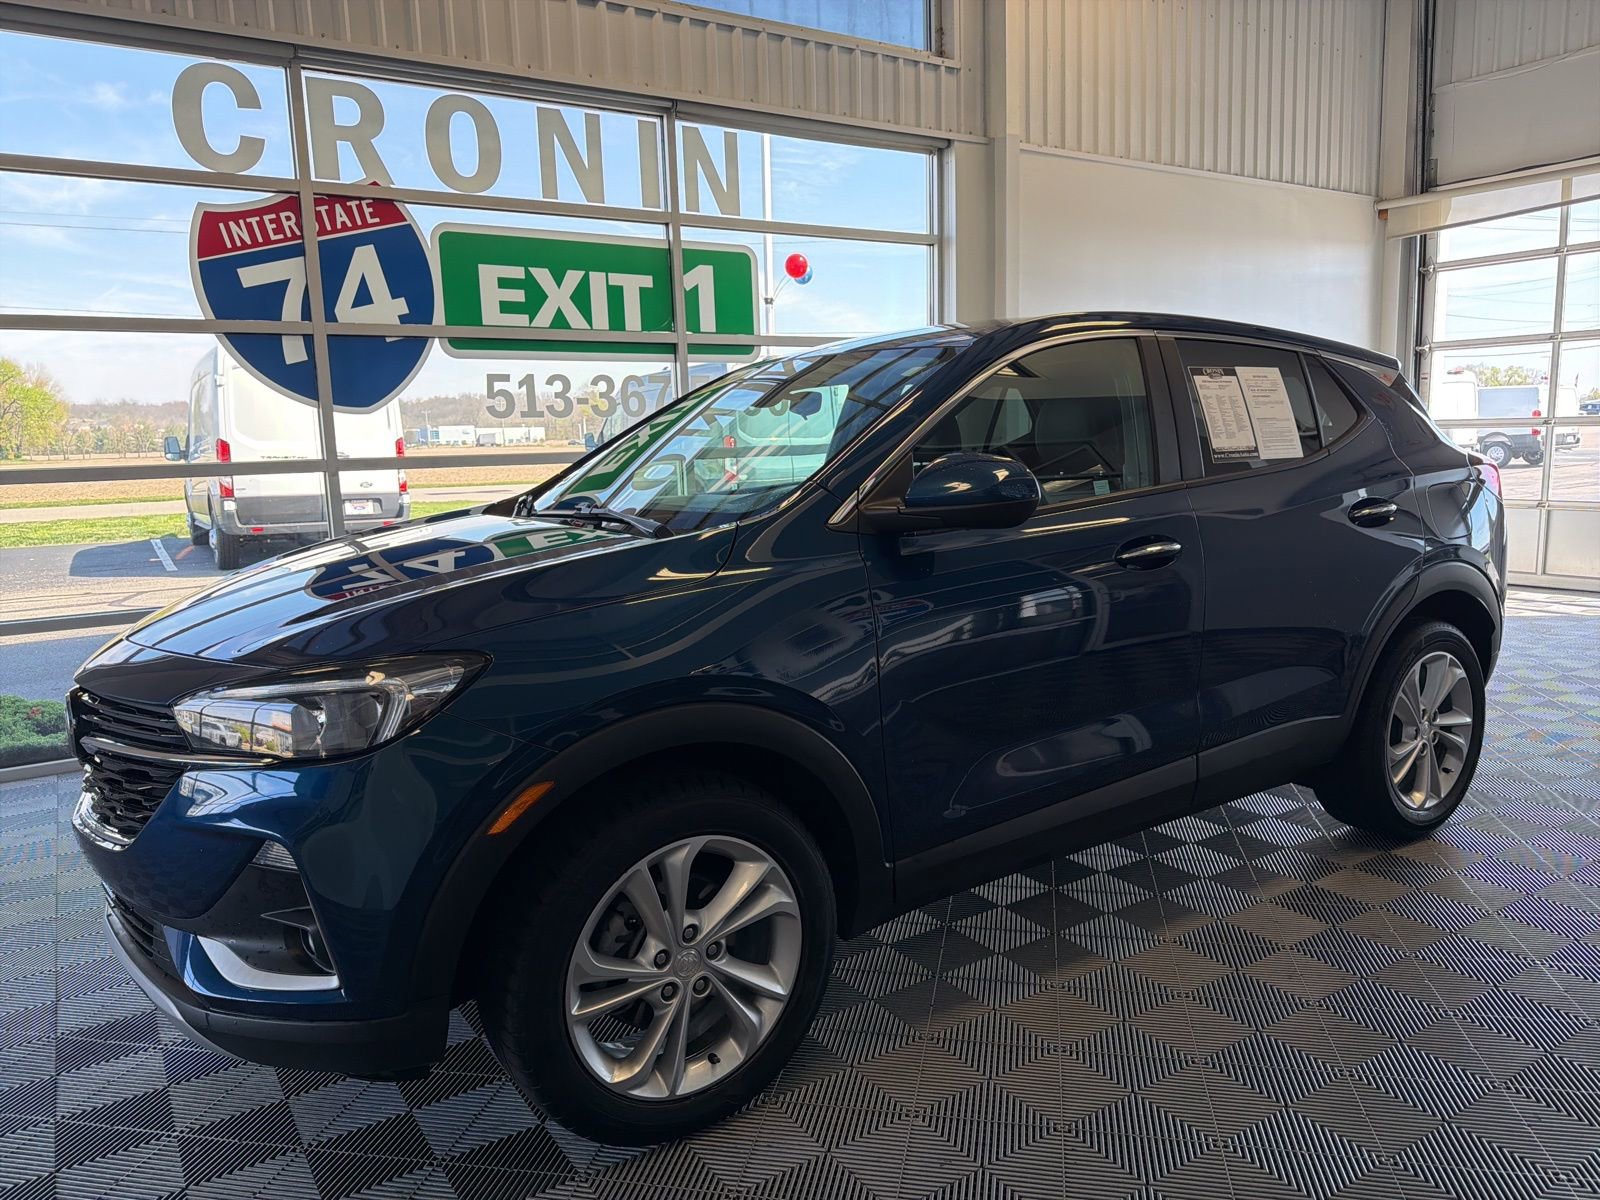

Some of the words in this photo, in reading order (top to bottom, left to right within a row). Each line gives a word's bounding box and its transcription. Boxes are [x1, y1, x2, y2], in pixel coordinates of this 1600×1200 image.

[171, 62, 741, 217] CRONIN
[218, 199, 380, 249] INTERTATE
[236, 244, 410, 366] 74
[478, 264, 654, 331] EXIT
[683, 264, 717, 334] 1
